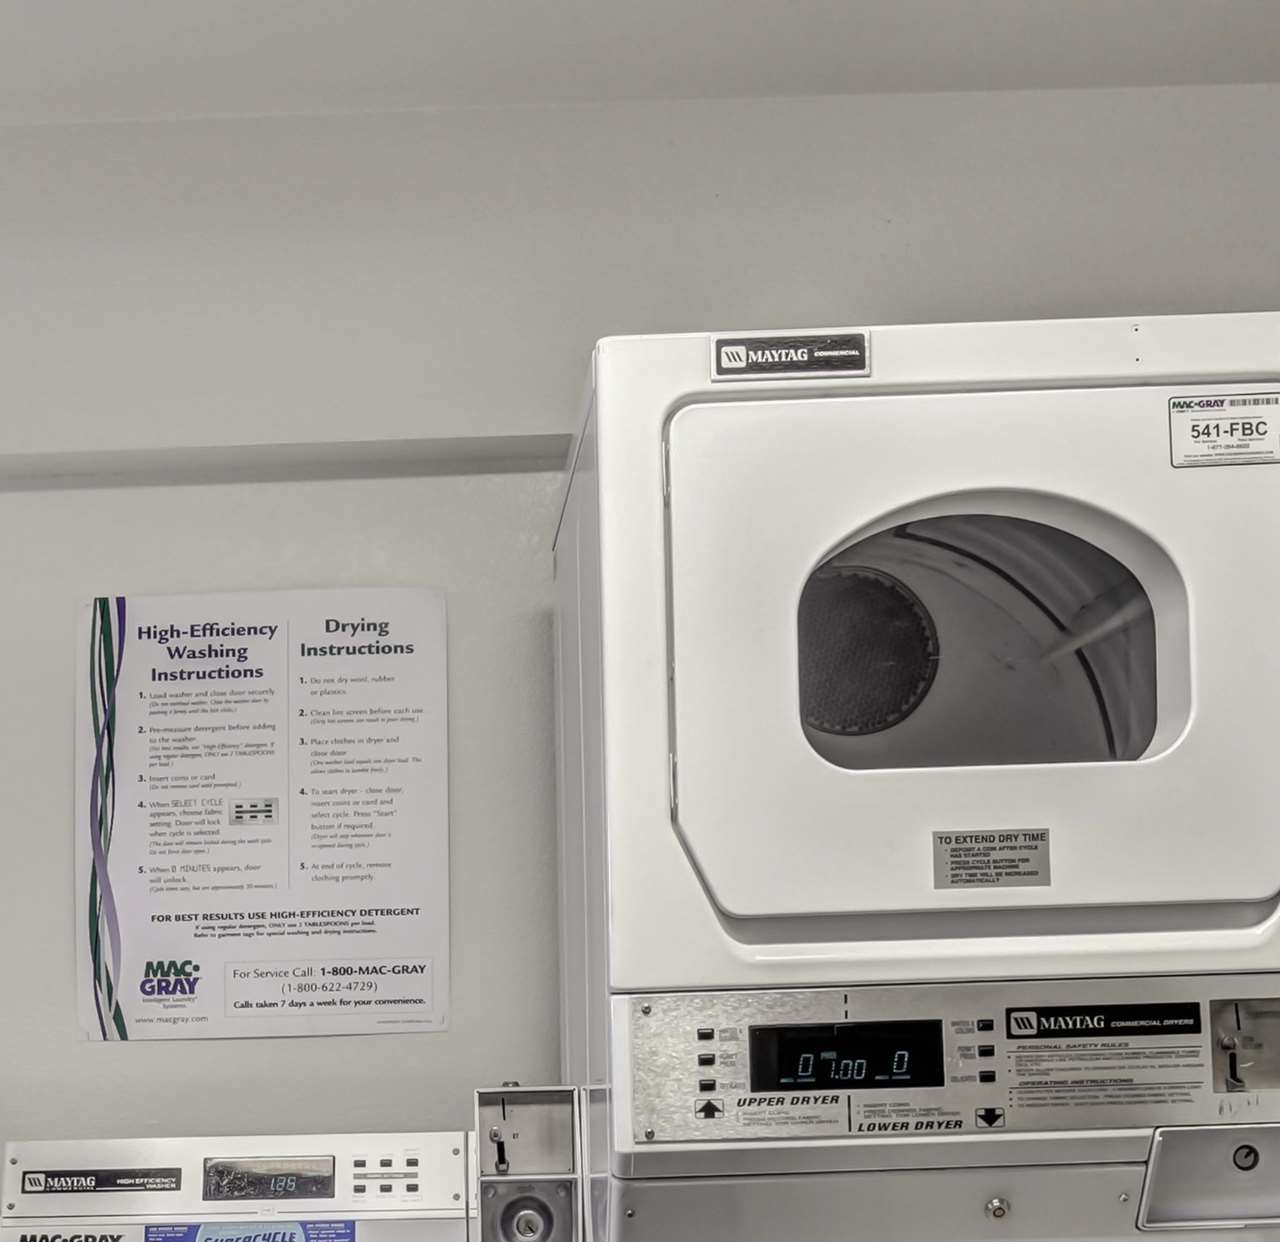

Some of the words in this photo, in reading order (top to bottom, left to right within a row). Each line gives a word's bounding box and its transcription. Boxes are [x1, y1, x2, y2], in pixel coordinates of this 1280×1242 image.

[748, 349, 808, 363] MAYTAG
[1191, 421, 1268, 438] 541-FBC
[137, 622, 278, 644] High-Efficiency
[325, 618, 390, 637] Drying
[166, 644, 249, 662] Washing
[300, 640, 415, 657] Instructions
[151, 665, 264, 682] Instructions
[937, 836, 952, 845] TO
[955, 834, 996, 844] EXTEND
[998, 833, 1019, 843] DRY
[1022, 832, 1047, 842] TIME
[137, 866, 147, 874] 5.
[180, 864, 210, 872] MINUTES
[151, 914, 171, 923] FOR
[174, 913, 199, 922] BEST
[202, 912, 245, 921] RESULTS
[248, 911, 267, 920] USE
[270, 909, 356, 919] HIGH-EFFICIENCY
[359, 907, 421, 917] DETERGENT
[233, 969, 250, 979] For
[253, 968, 289, 978] Service
[320, 964, 426, 976] 1-800-MAC-GRAY
[140, 977, 200, 996] GRAY
[281, 981, 378, 994] (1-800-622-4729)
[233, 1001, 253, 1009] Calls
[255, 1000, 278, 1008] taken
[280, 1000, 285, 1008] 7
[288, 999, 307, 1009] days
[316, 998, 337, 1006] week
[339, 998, 351, 1006] for
[354, 999, 373, 1008] your
[375, 997, 426, 1005] convenience.
[1039, 1015, 1105, 1030] MAYTAG
[1110, 1020, 1162, 1028] COMMERCIAL
[798, 1054, 814, 1076] 0
[830, 1059, 867, 1080] 1.00
[893, 1051, 908, 1073] 0
[737, 1097, 785, 1107] UPPER
[790, 1095, 840, 1105] DRYER
[857, 1122, 910, 1133] LOWER
[914, 1120, 964, 1130] DRYER
[46, 1176, 96, 1187] MAYTAG
